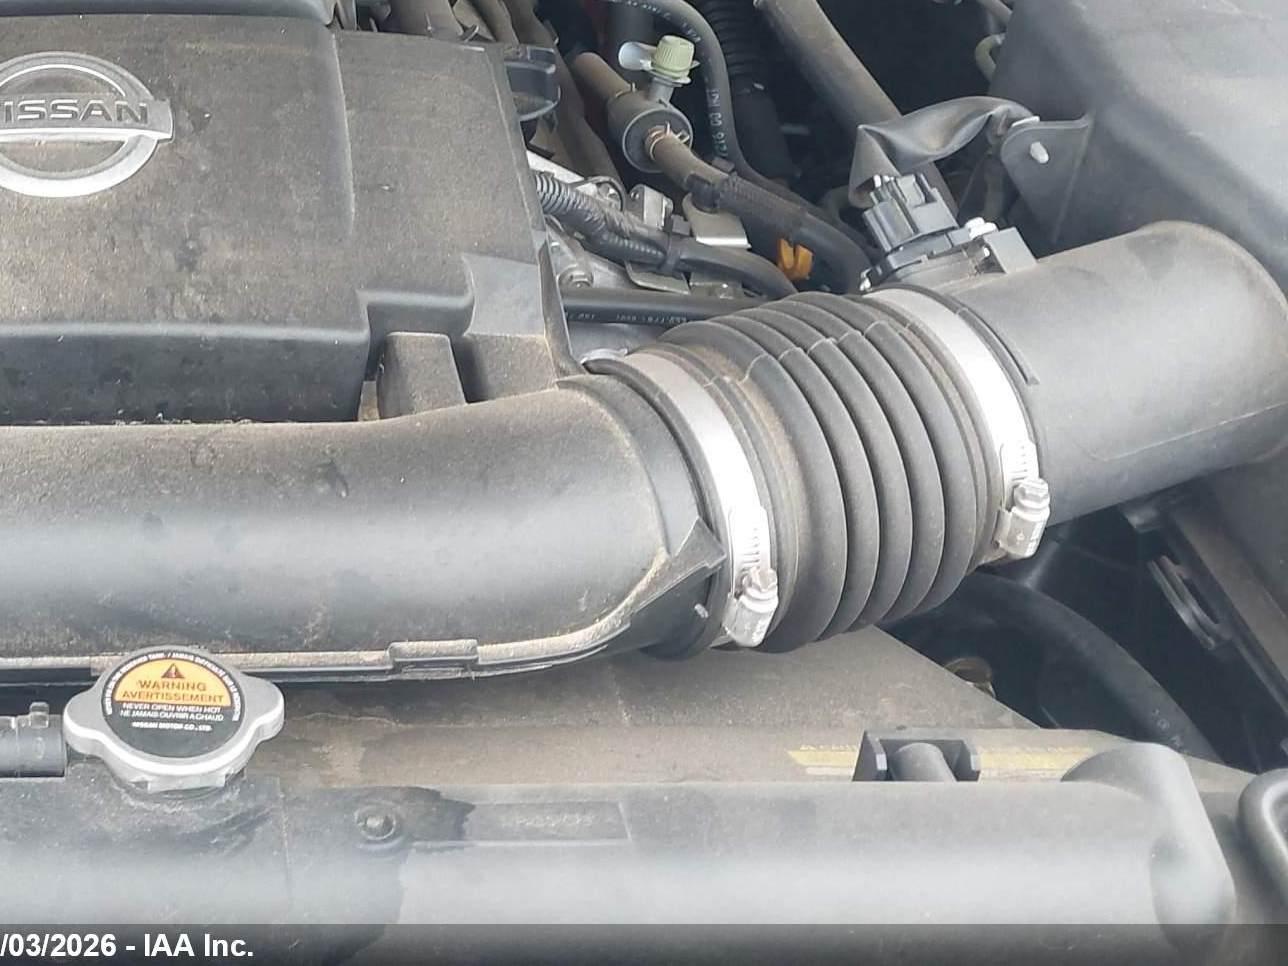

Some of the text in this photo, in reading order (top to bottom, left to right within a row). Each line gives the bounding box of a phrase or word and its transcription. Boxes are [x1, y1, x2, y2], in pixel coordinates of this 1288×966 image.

[137, 679, 207, 692] WARNING
[122, 690, 224, 703] AVERTISSEMENT
[122, 702, 222, 714] NEVER OPEN WHEN HOT
[132, 710, 158, 718] JAMAIS
